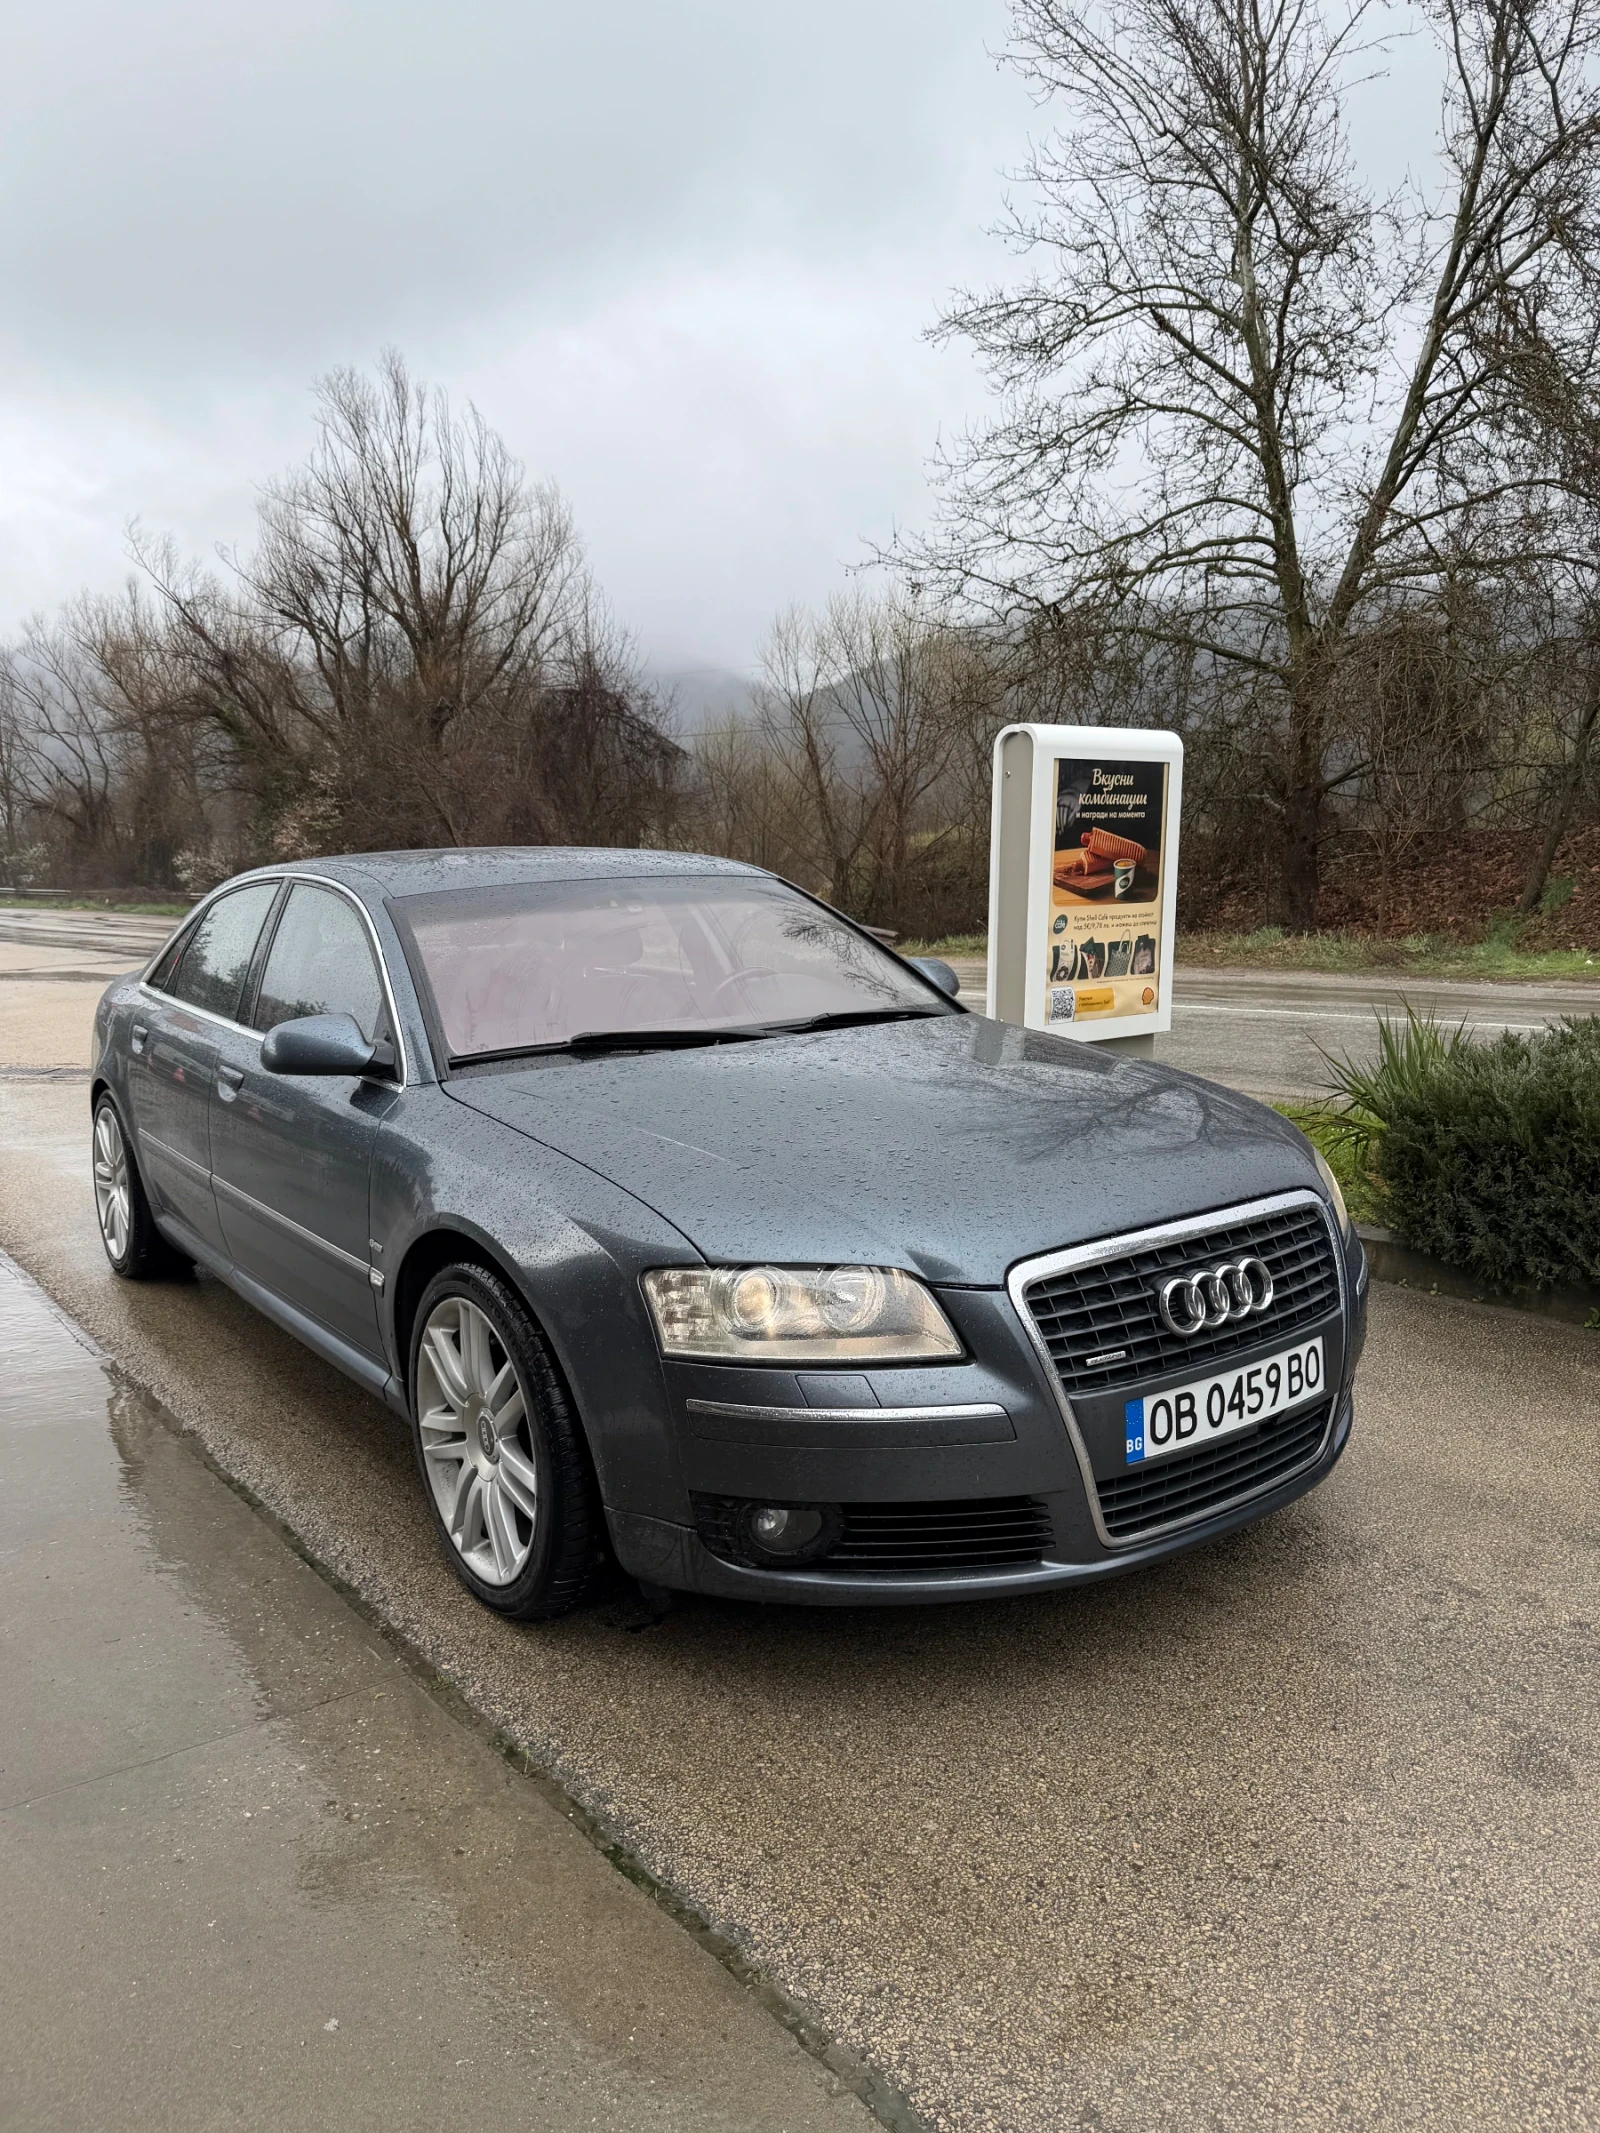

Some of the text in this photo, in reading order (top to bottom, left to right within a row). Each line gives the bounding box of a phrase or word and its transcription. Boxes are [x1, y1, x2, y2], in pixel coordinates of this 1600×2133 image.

[1093, 768, 1134, 790] Вкусни
[1079, 787, 1147, 810] комбинации
[1081, 811, 1108, 821] награди
[1150, 1345, 1320, 1445] OB 0459 BO
[1126, 1437, 1143, 1454] BG
